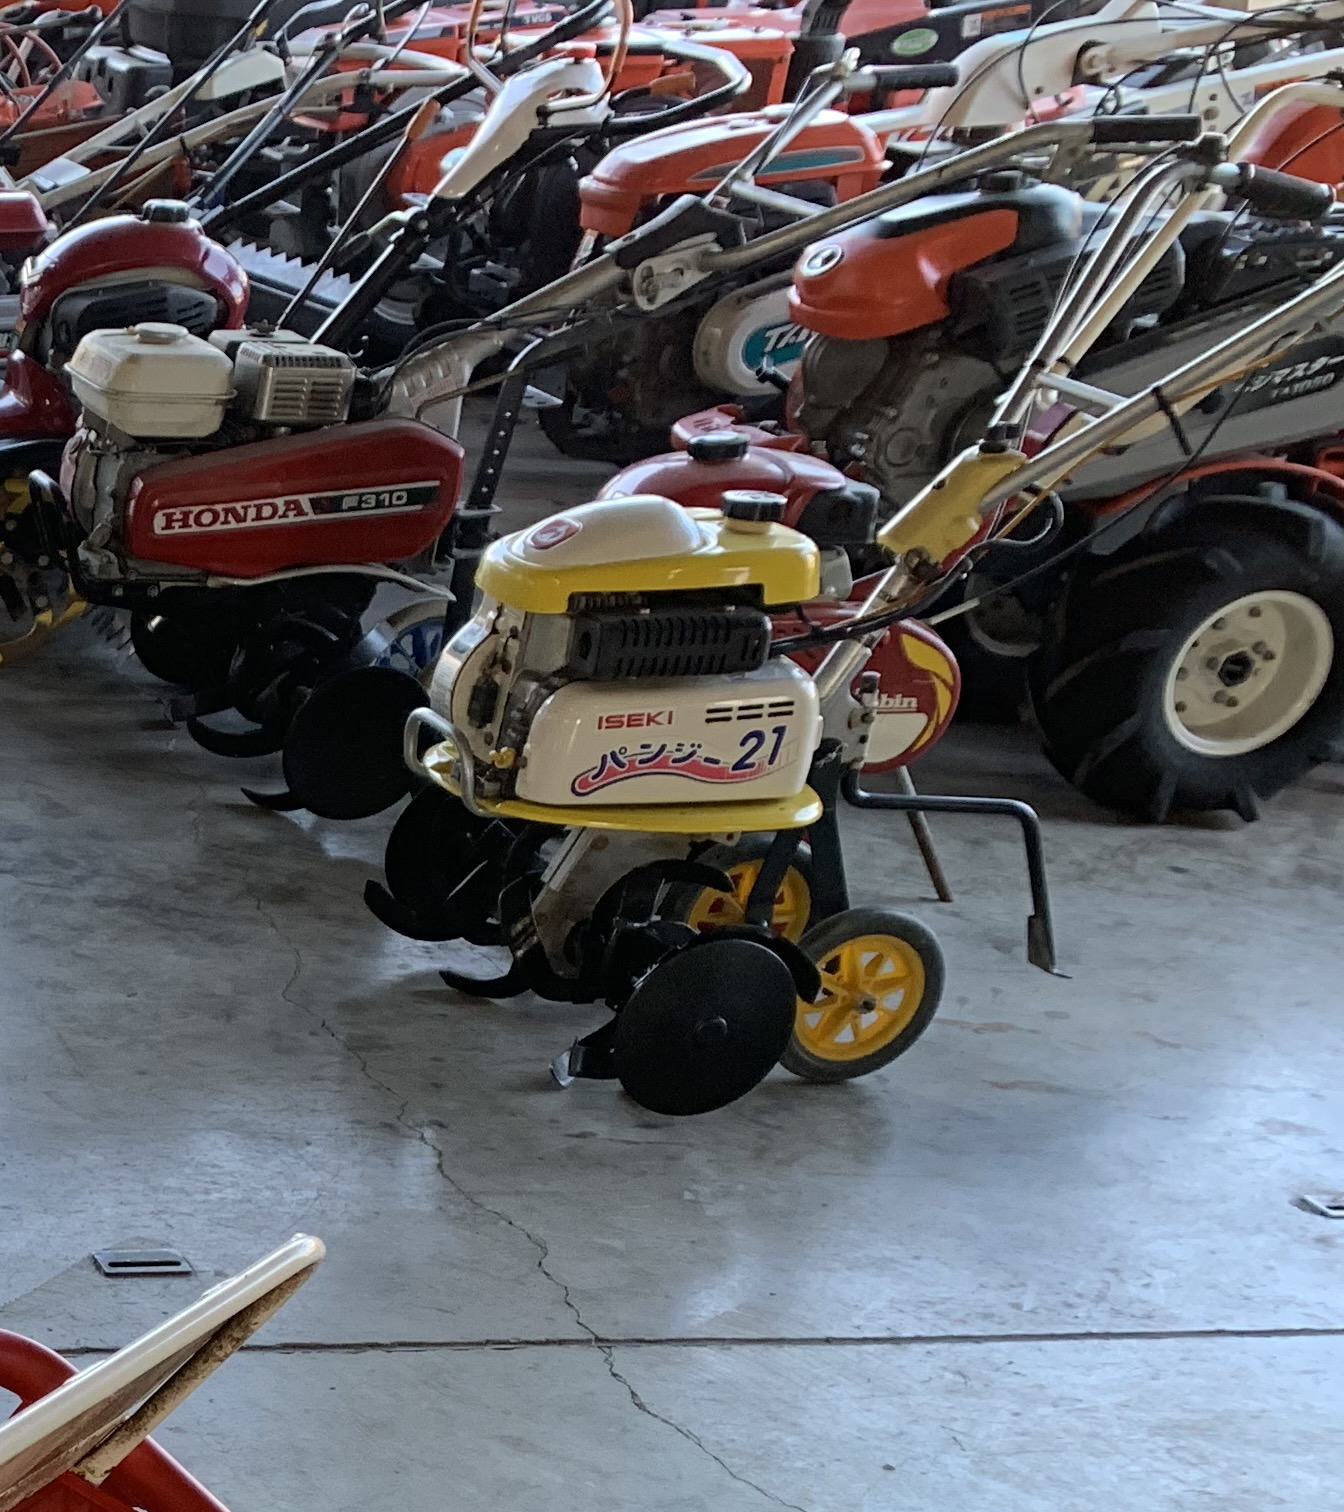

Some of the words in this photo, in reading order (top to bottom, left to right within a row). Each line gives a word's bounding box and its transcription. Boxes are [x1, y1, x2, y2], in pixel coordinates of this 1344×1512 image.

[161, 499, 309, 531] HONDA
[342, 491, 408, 510] F310
[597, 711, 673, 730] ISEKI
